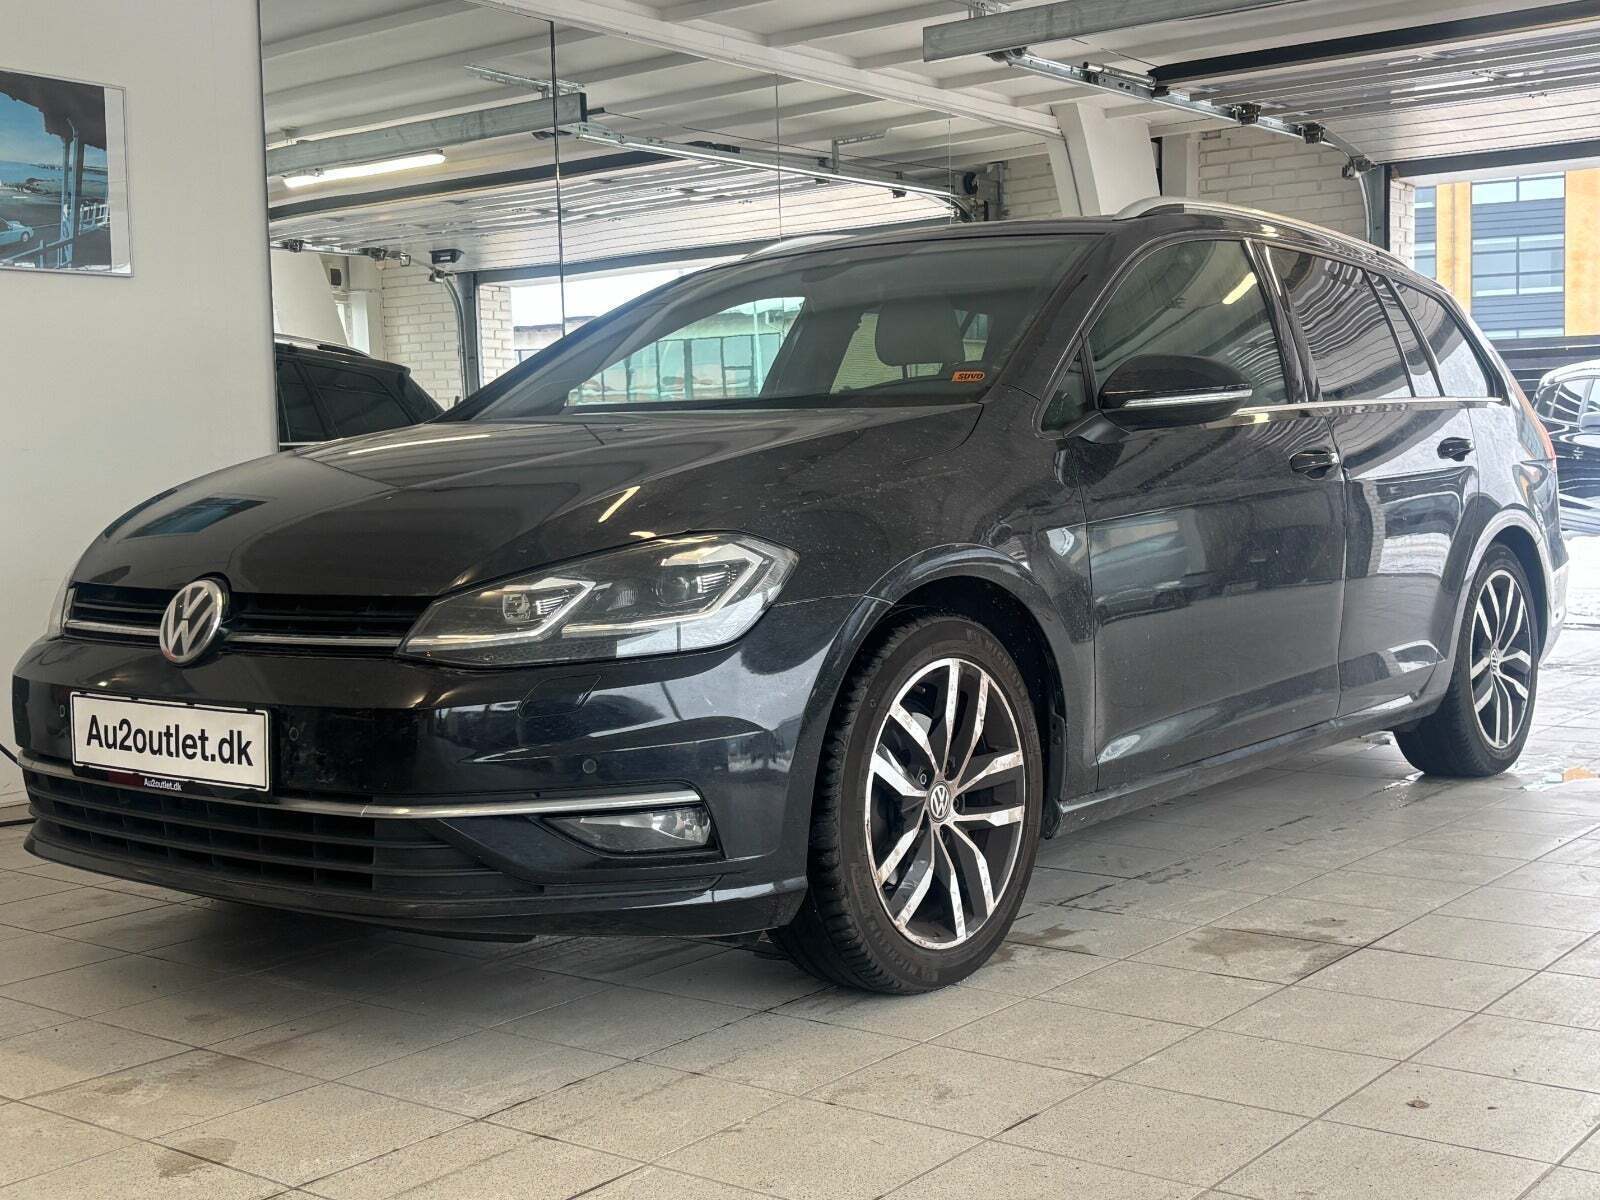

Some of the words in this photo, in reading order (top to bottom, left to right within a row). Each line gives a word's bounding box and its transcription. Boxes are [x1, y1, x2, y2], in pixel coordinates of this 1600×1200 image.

[160, 580, 223, 665] VW
[86, 715, 253, 766] Au2outlet.dk
[143, 777, 182, 791] Au2outlet.dk
[930, 785, 949, 819] VW
